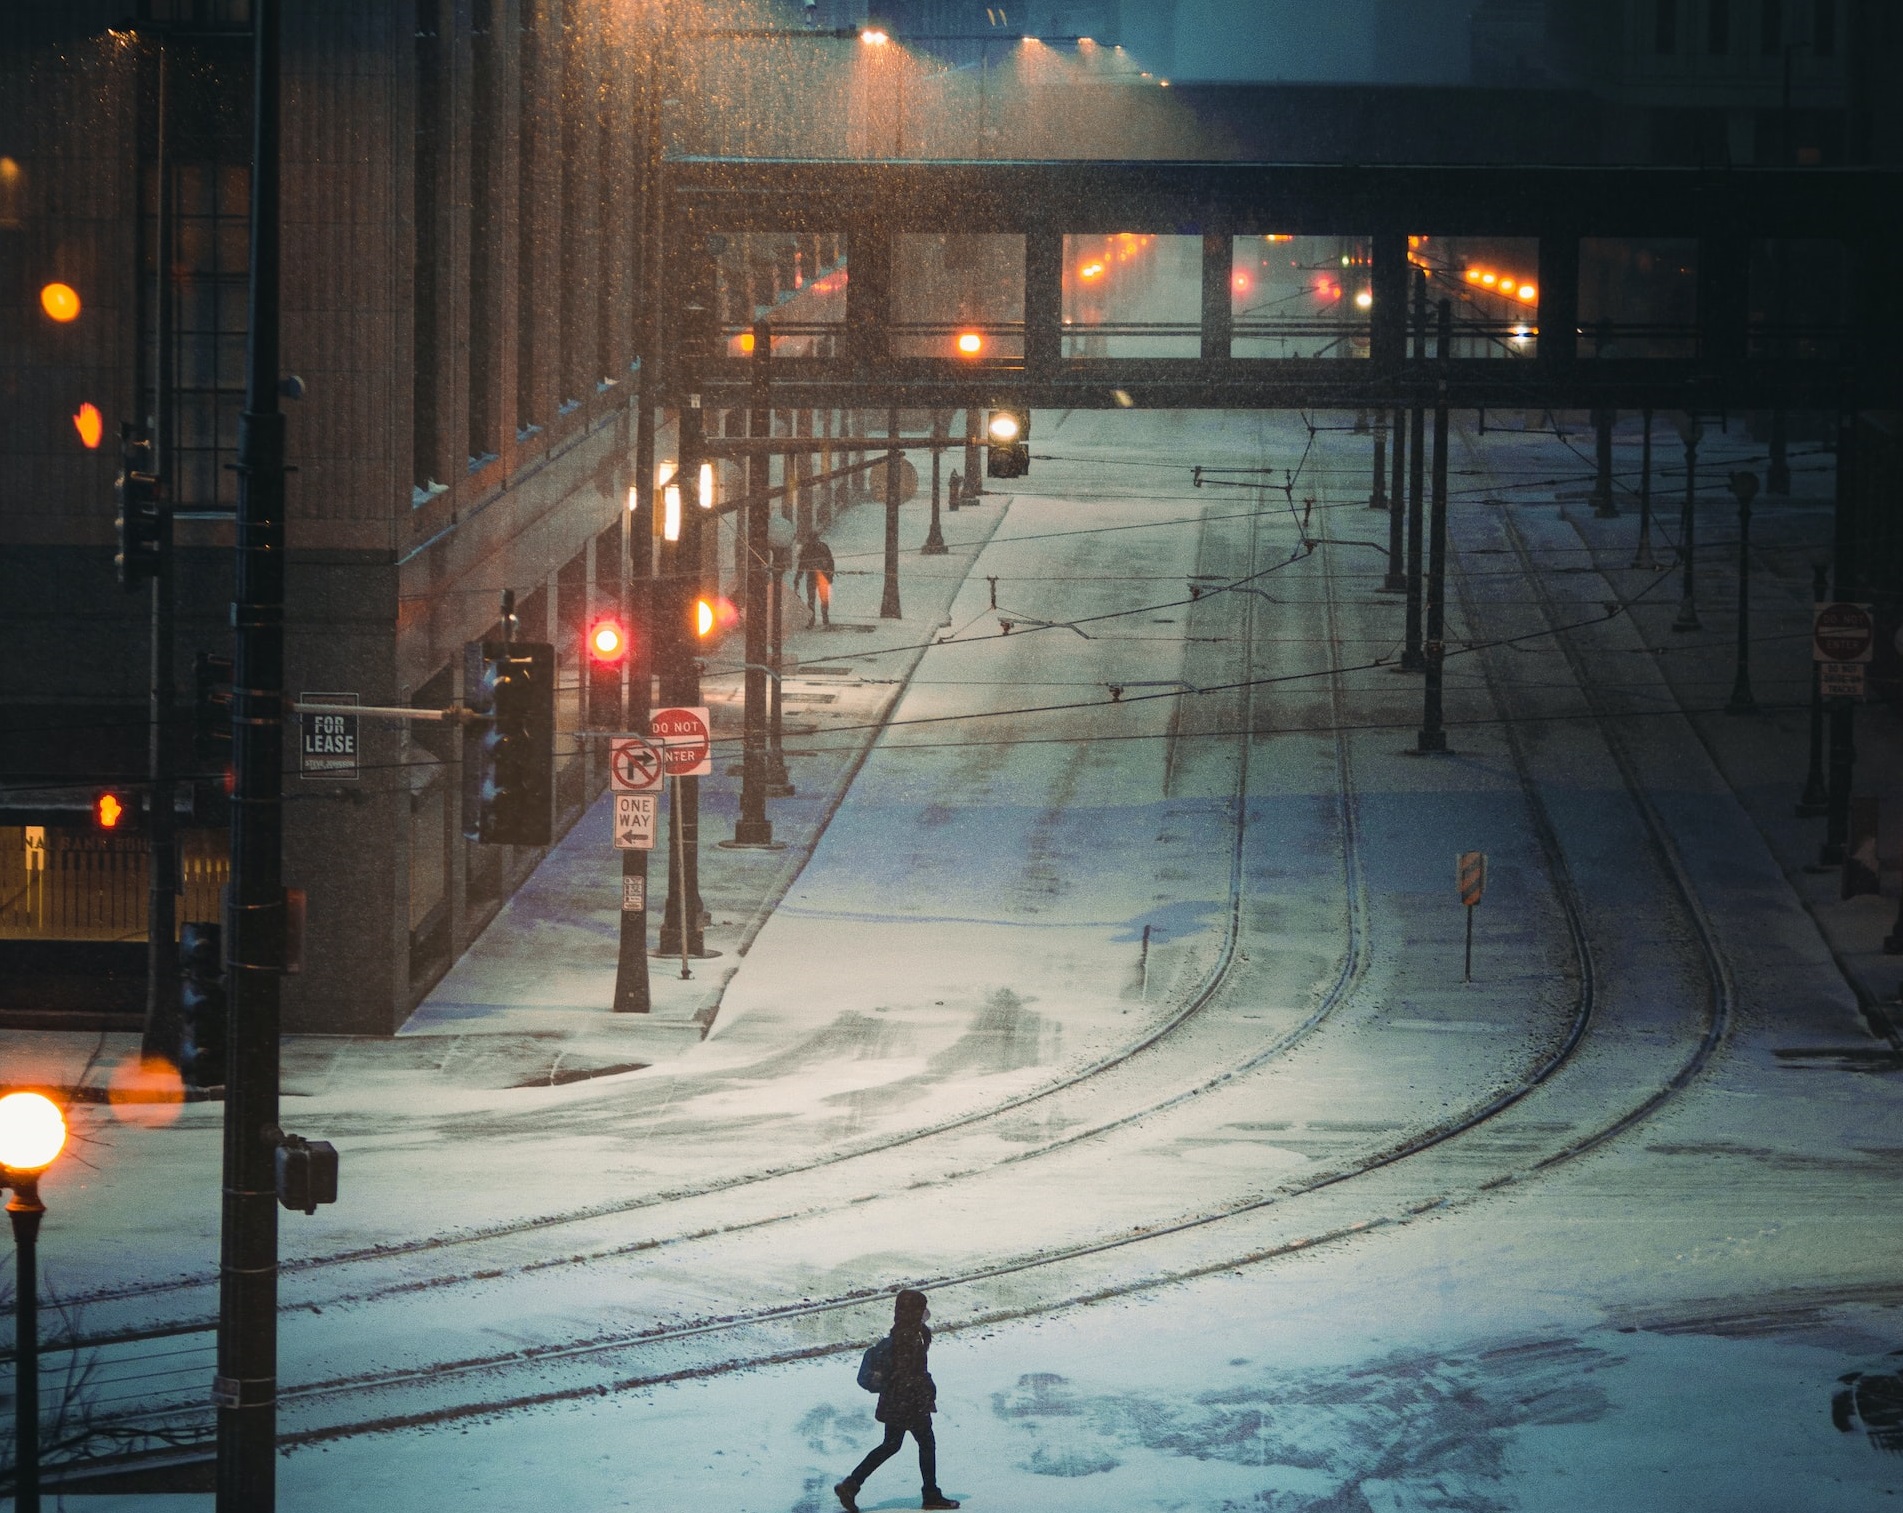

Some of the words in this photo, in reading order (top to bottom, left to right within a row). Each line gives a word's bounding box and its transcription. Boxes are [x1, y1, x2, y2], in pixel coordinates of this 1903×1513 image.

[1843, 614, 1865, 624] NOT
[1826, 640, 1860, 649] ENTER
[315, 716, 344, 734] FOR
[652, 722, 668, 733] DO
[674, 721, 699, 733] NOT
[305, 735, 354, 753] LEASE
[665, 751, 695, 762] NTER
[620, 798, 650, 813] ONE
[619, 814, 650, 827] WAY
